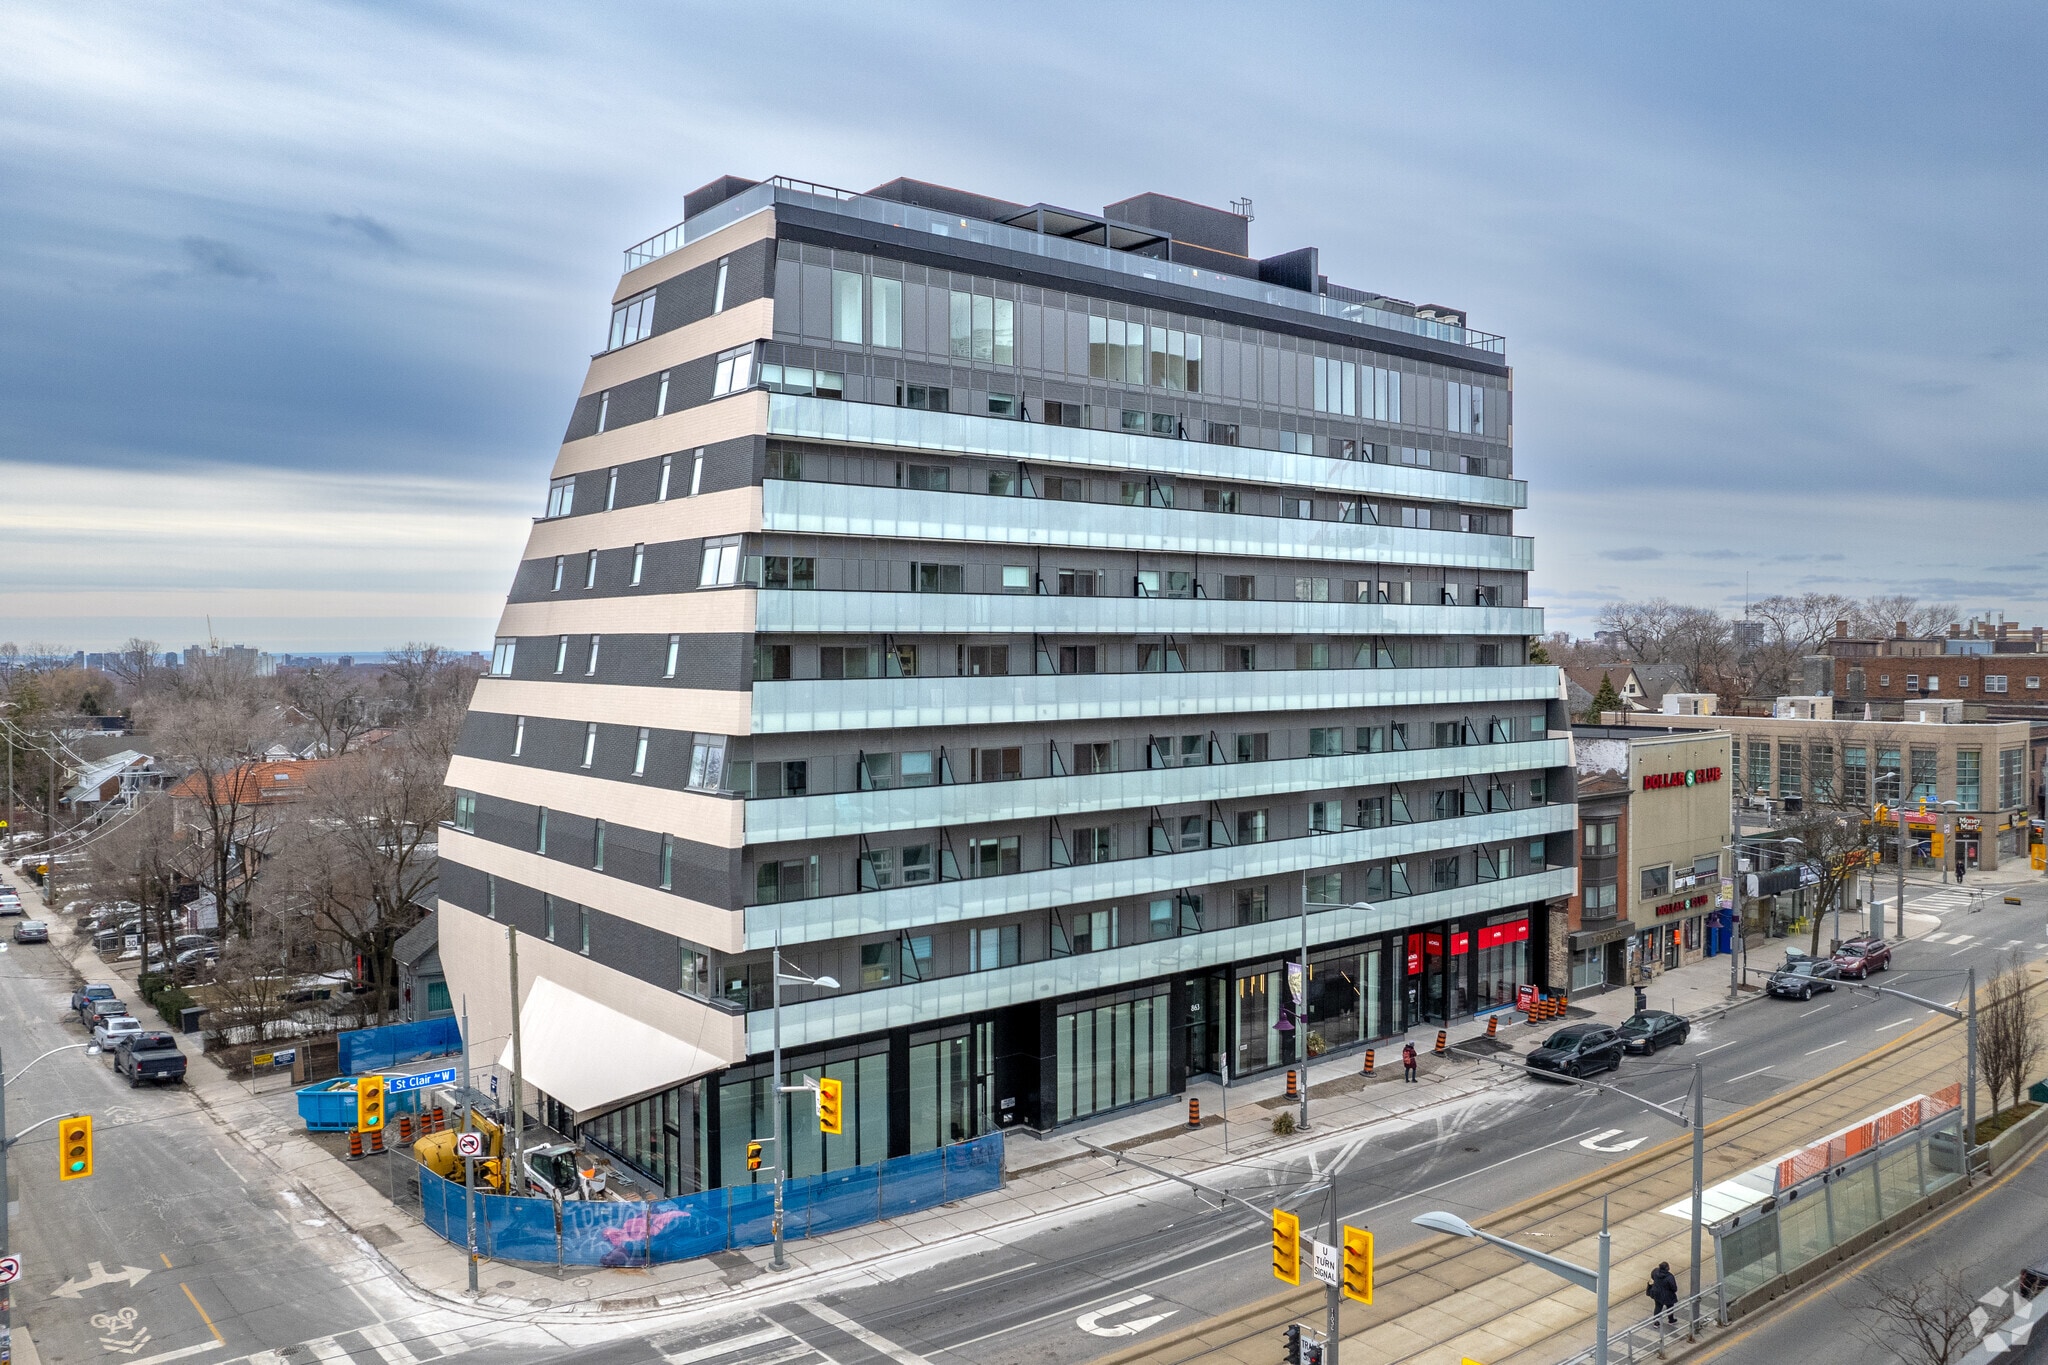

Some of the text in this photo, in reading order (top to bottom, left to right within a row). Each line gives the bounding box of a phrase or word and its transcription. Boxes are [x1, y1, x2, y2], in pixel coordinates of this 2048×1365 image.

[1643, 772, 1684, 790] DOLLAR
[1695, 767, 1721, 784] CLUB
[1959, 816, 1981, 825] Money
[1960, 822, 1978, 830] Mart
[1656, 901, 1684, 916] DOLLAR
[1691, 895, 1708, 907] CLUB
[1190, 1003, 1200, 1011] 863
[396, 1080, 406, 1089] St
[410, 1075, 431, 1086] Clair
[441, 1071, 450, 1080] W
[1322, 1247, 1328, 1255] U
[1316, 1256, 1335, 1270] TURN
[1314, 1267, 1335, 1282] SIGNAL
